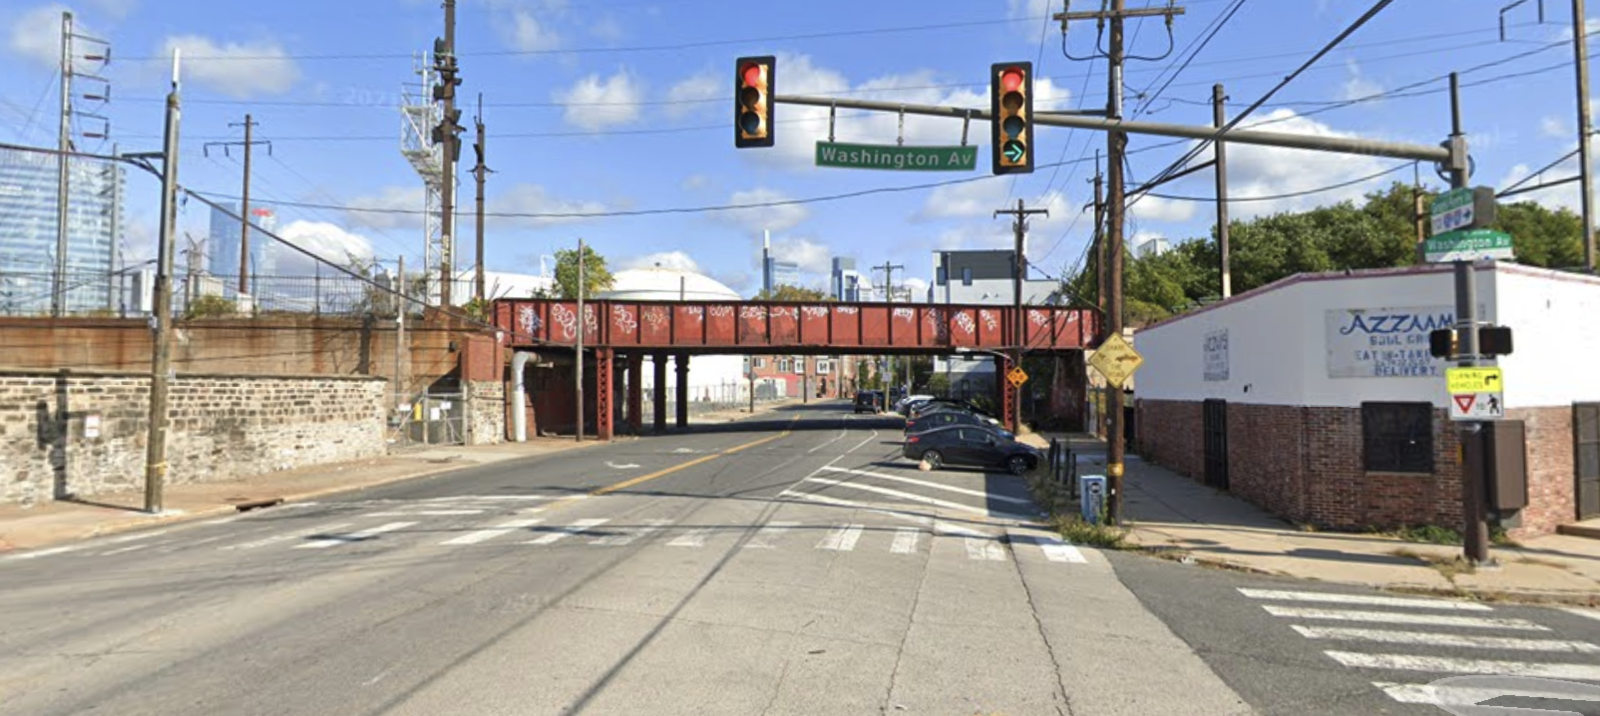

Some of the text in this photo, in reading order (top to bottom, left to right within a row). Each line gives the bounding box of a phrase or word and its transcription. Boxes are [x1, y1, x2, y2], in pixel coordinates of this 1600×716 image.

[821, 147, 972, 169] Washington Av
[1426, 238, 1493, 252] Washington
[1354, 350, 1378, 361] EAT
